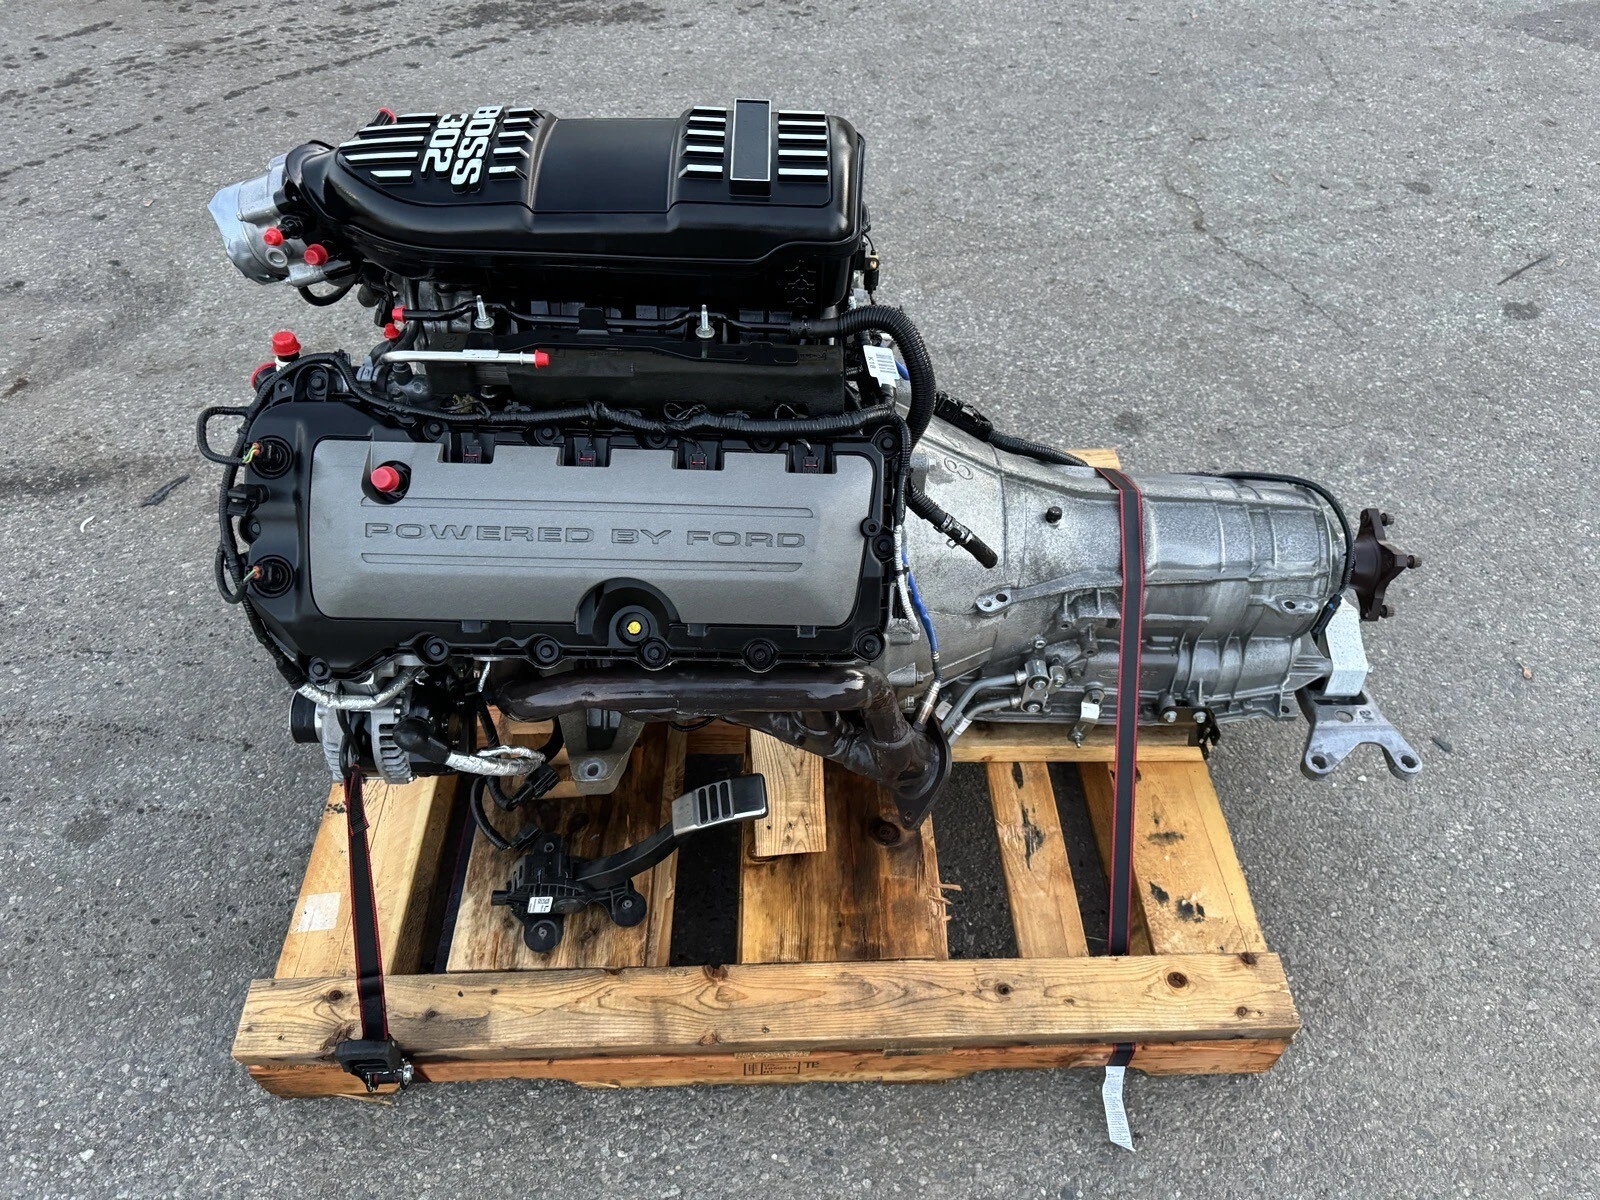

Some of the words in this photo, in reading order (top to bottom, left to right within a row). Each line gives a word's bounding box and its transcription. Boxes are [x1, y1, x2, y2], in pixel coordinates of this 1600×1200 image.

[420, 112, 469, 173] 302
[451, 105, 504, 185] BOSS
[364, 522, 595, 543] POWERED
[610, 528, 672, 545] BY
[686, 530, 806, 547] FORD
